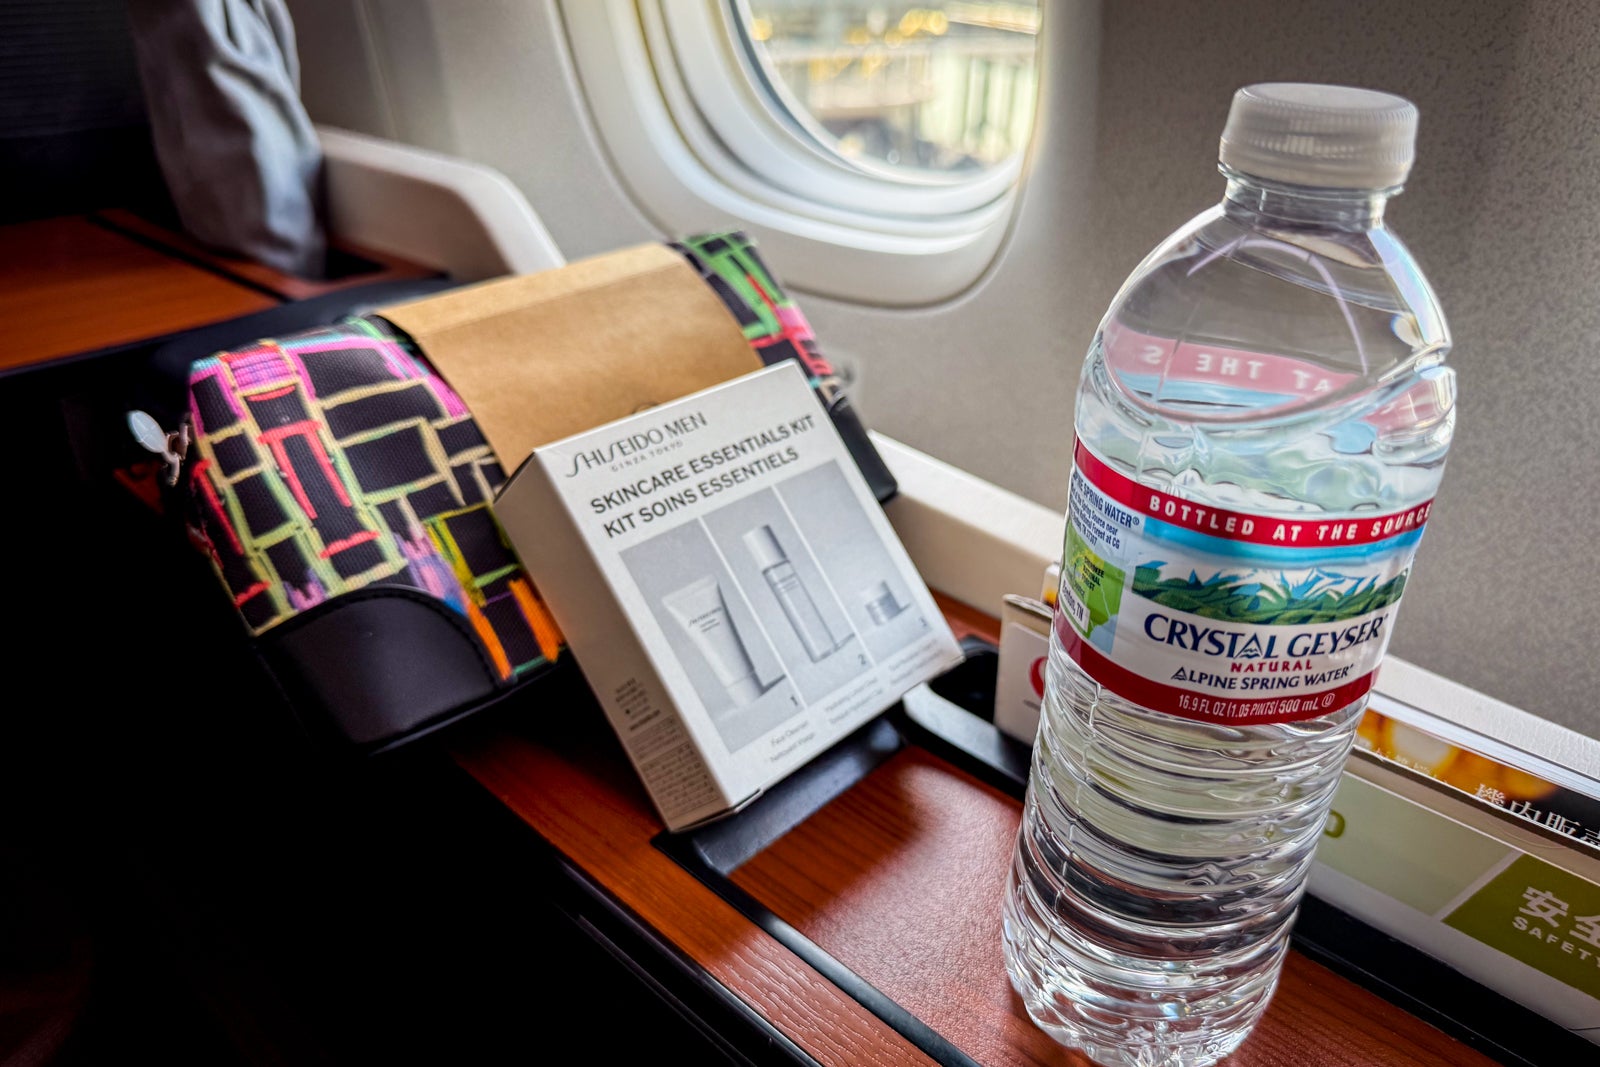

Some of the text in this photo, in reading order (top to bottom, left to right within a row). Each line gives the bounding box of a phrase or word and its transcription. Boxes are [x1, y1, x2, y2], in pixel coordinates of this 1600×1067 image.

[566, 412, 708, 477] SHISEIDO MEN
[611, 440, 683, 472] GINZA TOKYO
[590, 414, 816, 515] SKINCARE ESSENTIALS KIT
[603, 447, 800, 539] KIT SOINS ESSENTIELS
[1084, 483, 1104, 511] SPRING
[1092, 510, 1106, 529] Source
[1106, 522, 1119, 535] near
[1149, 495, 1255, 536] BOTTLED
[1272, 524, 1302, 542] AT
[1318, 523, 1358, 541] THE
[1092, 521, 1106, 541] Forest
[1106, 534, 1112, 544] at
[1112, 537, 1121, 549] CG
[1076, 602, 1084, 622] TN
[1143, 612, 1385, 660] CRYSTAL GEYSER
[858, 654, 867, 665] 2
[1230, 659, 1312, 673] NATURAL
[1171, 666, 1350, 690] ALPINE SPRING WATER
[790, 695, 798, 707] 1
[1178, 694, 1199, 711] 16.9
[1199, 699, 1210, 714] FL
[1212, 701, 1225, 717] OZ
[1278, 699, 1300, 713] 500
[1301, 697, 1319, 712] mL
